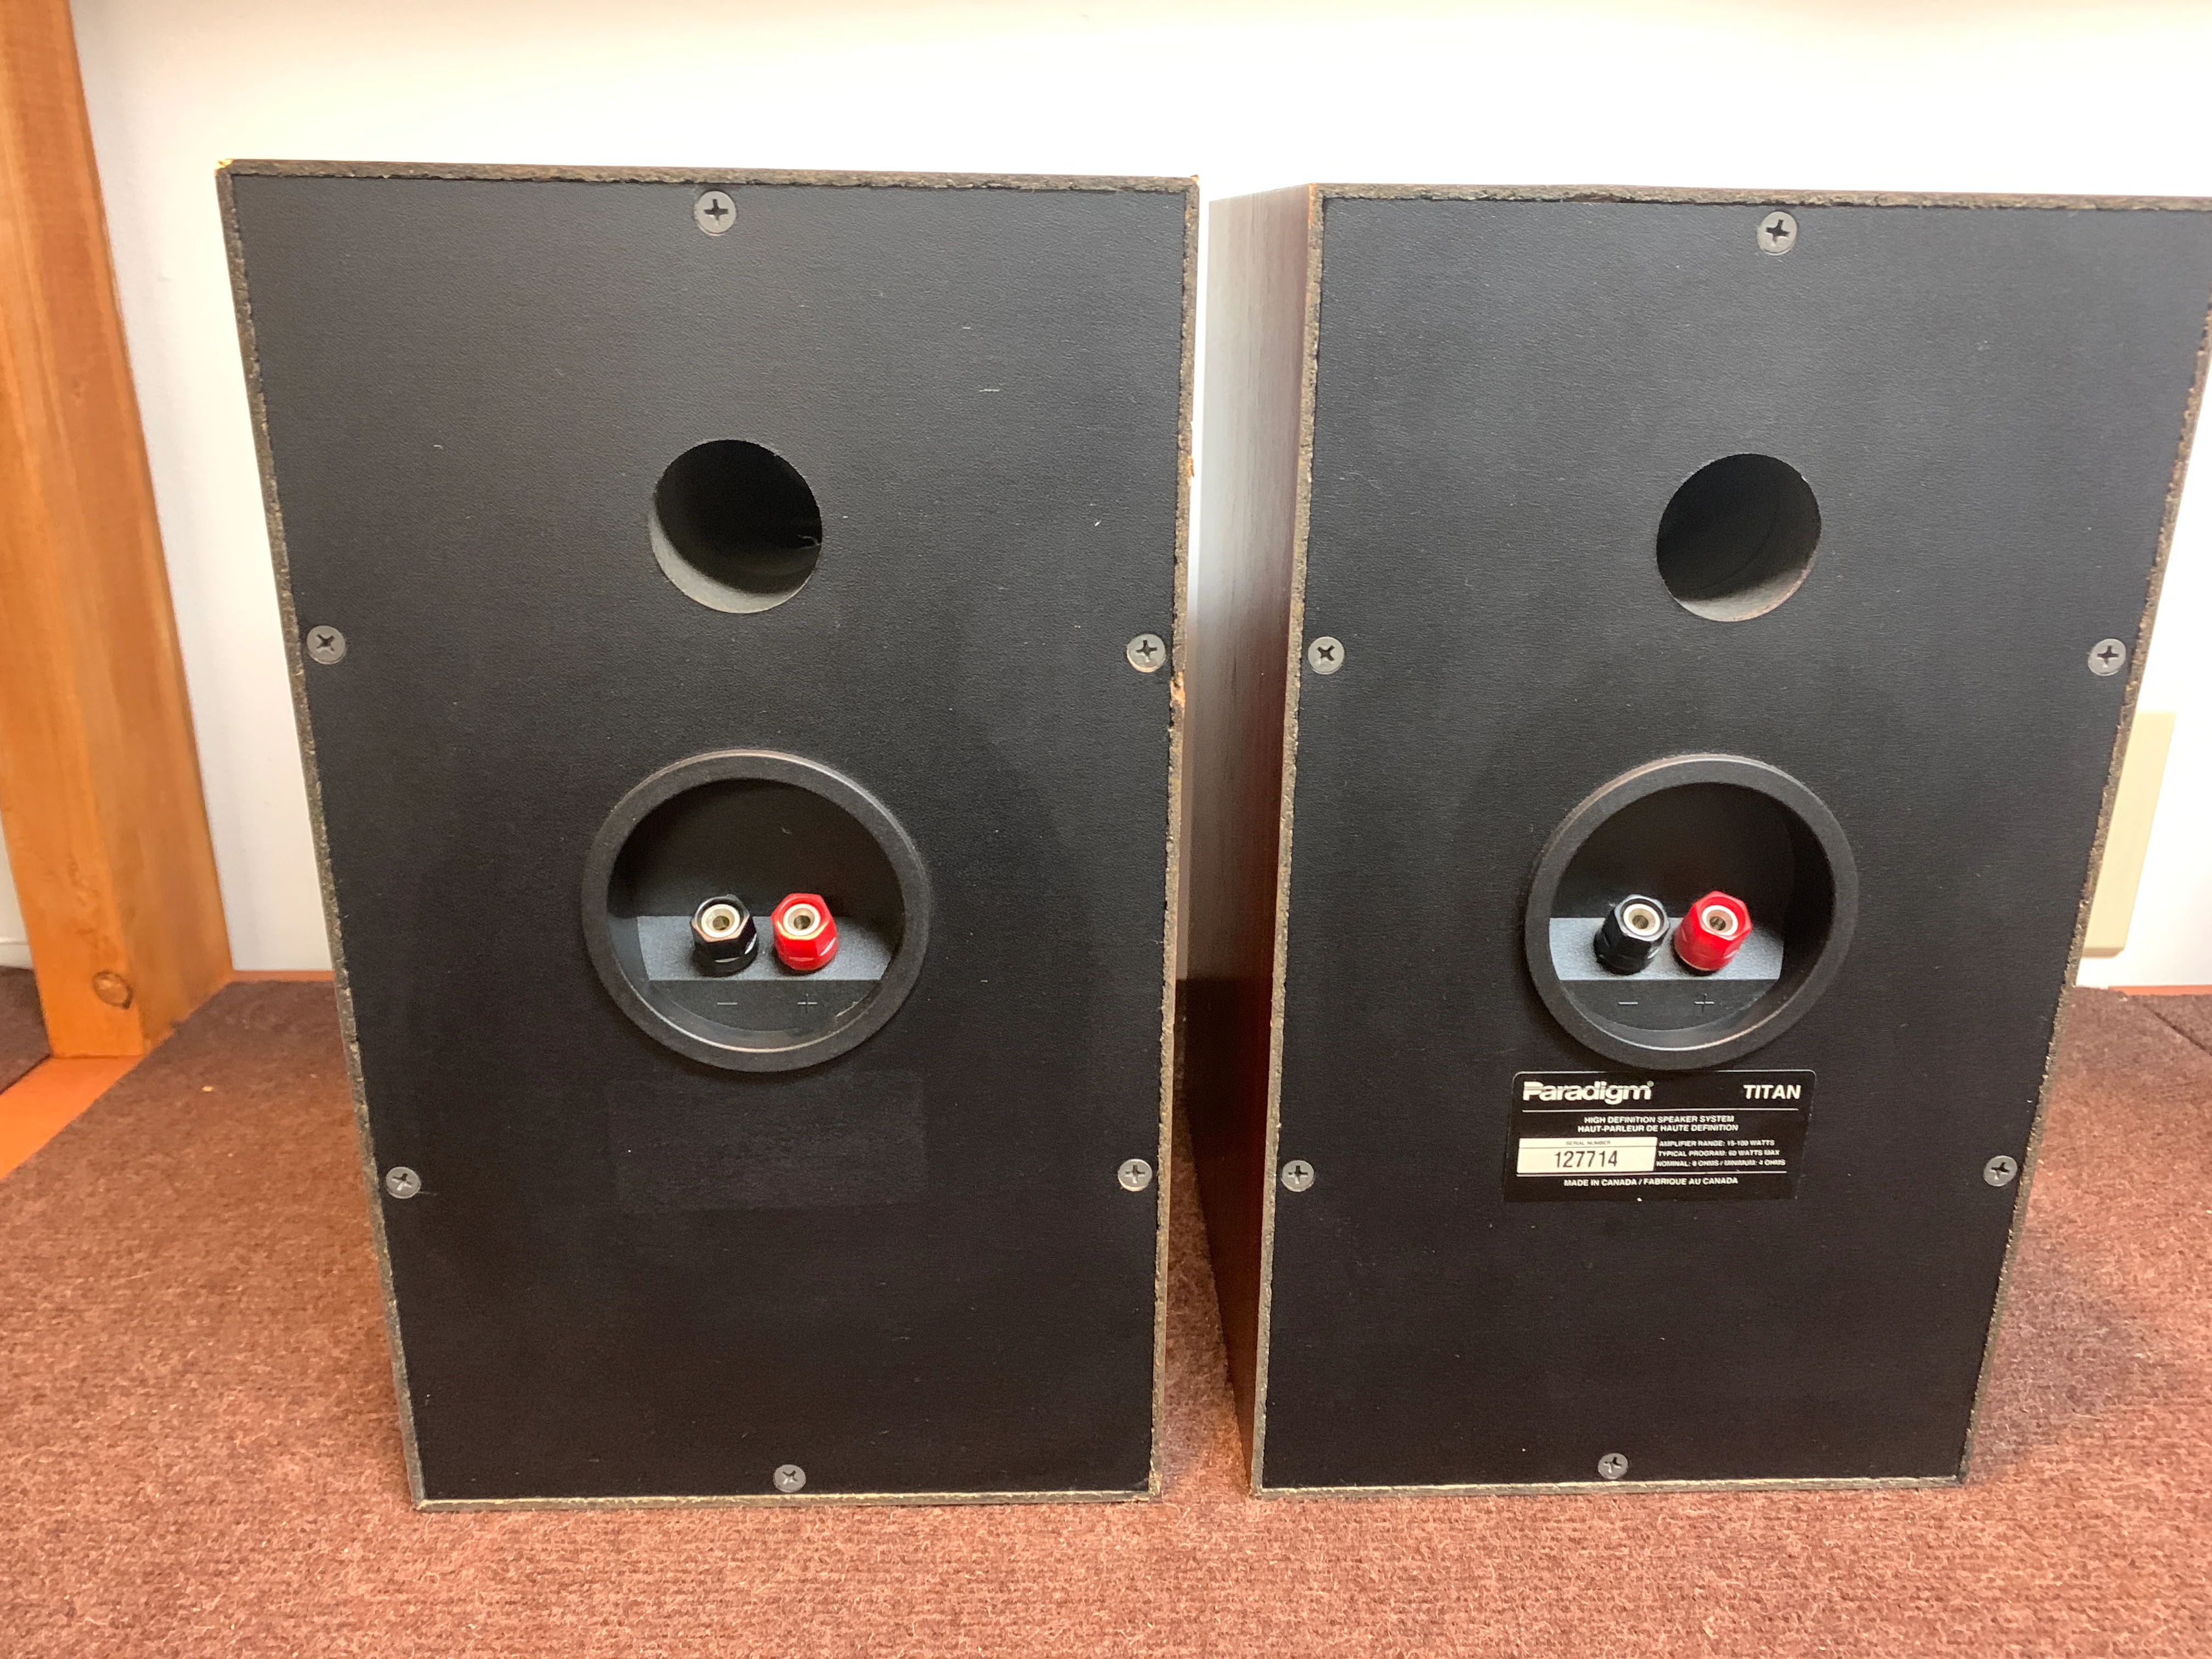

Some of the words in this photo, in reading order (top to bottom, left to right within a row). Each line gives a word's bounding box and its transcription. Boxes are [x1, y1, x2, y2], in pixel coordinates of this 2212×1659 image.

[1743, 1084, 1801, 1099] TITAN
[1554, 1150, 1618, 1168] 127714
[1643, 1177, 1687, 1186] FABRIQUE
